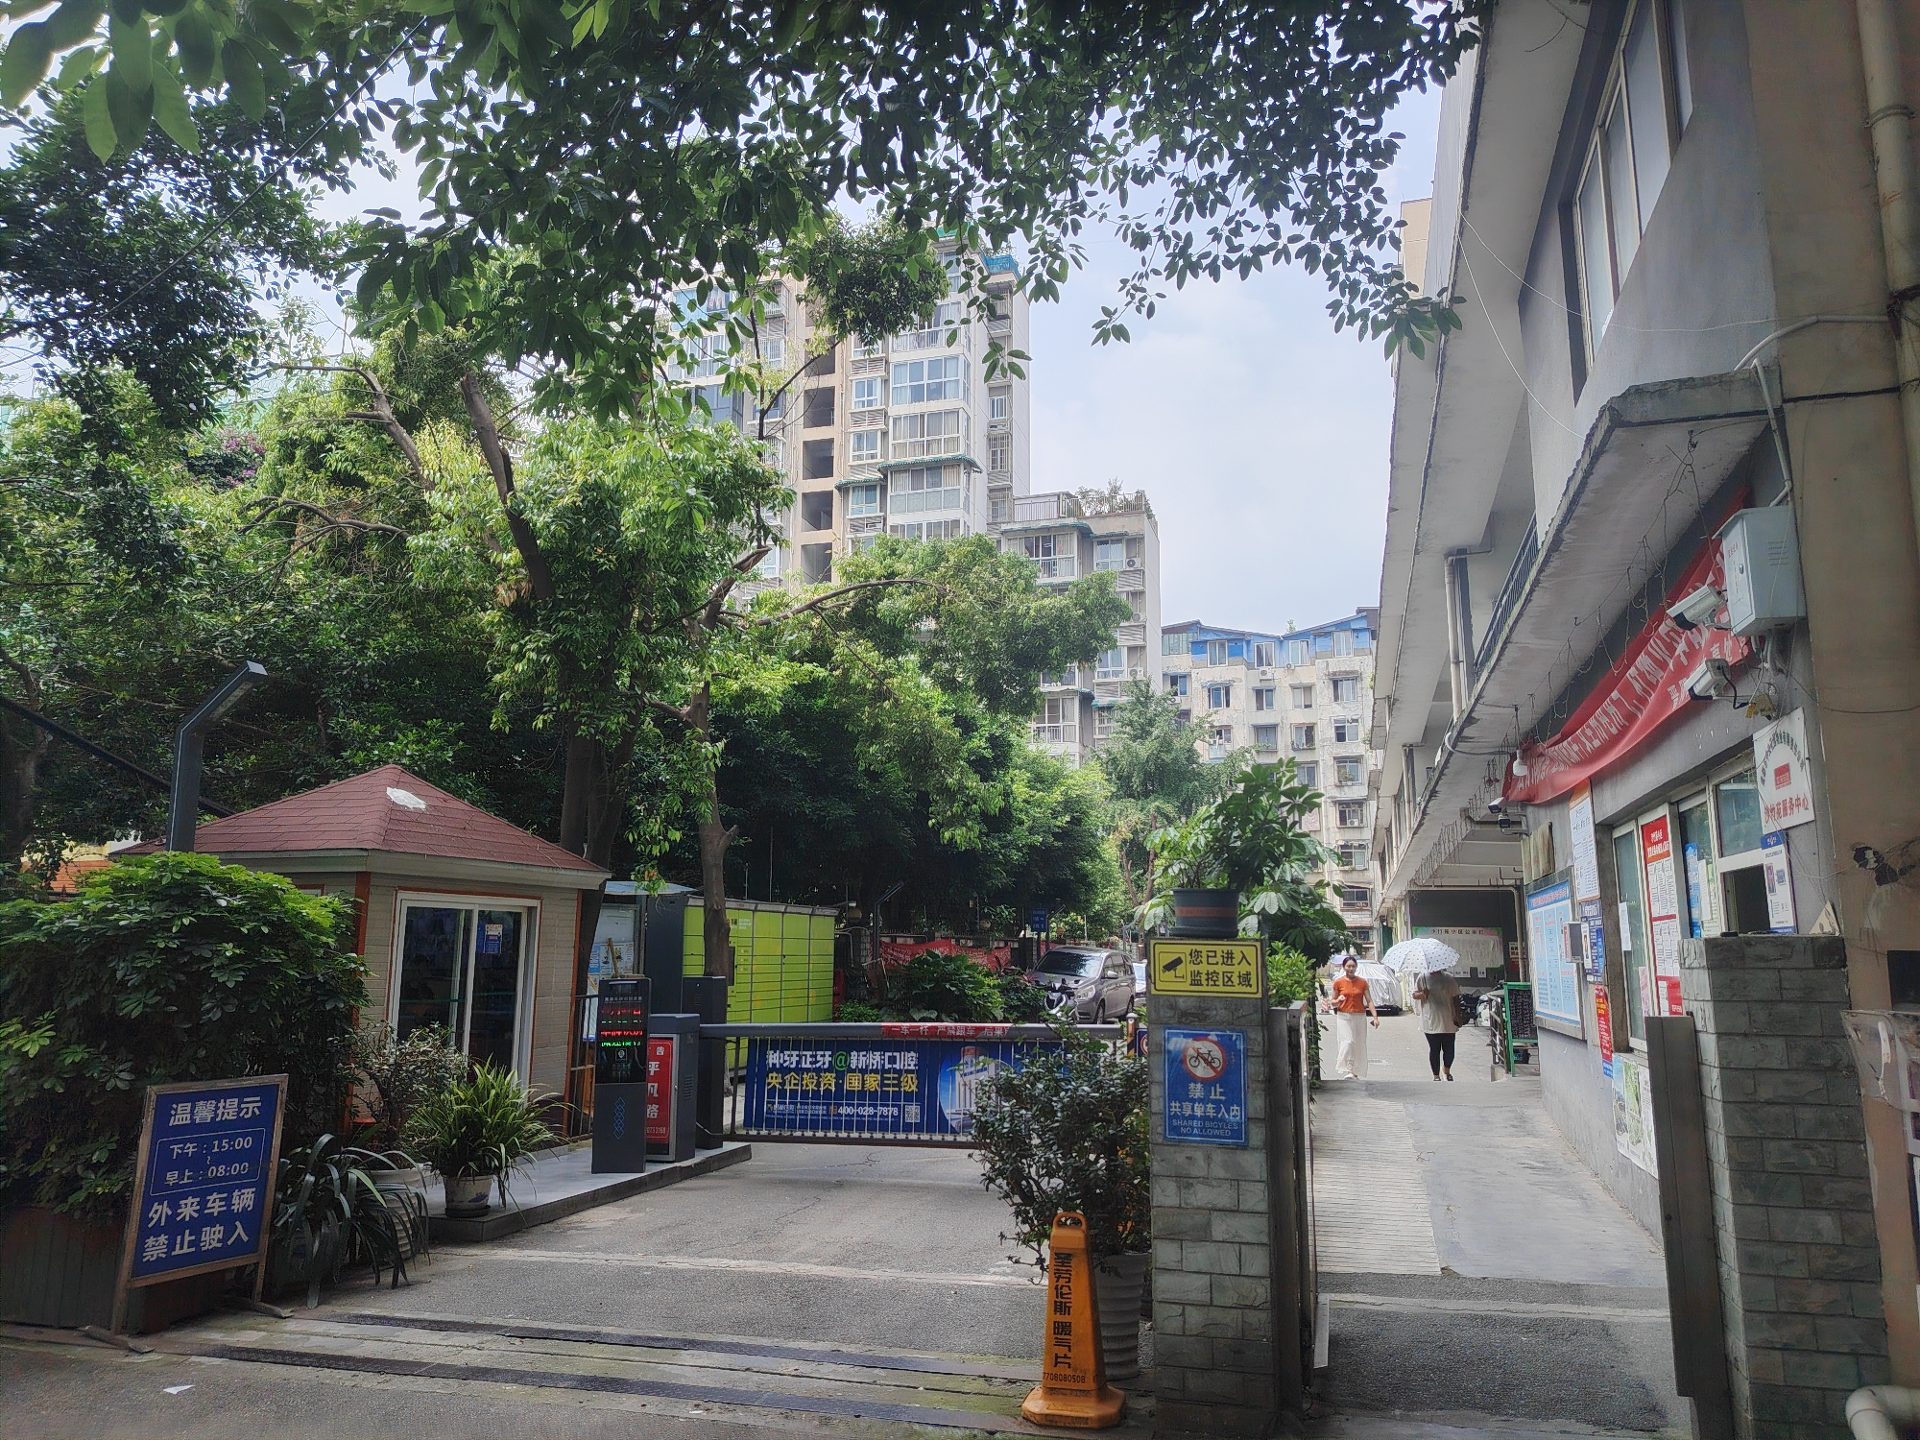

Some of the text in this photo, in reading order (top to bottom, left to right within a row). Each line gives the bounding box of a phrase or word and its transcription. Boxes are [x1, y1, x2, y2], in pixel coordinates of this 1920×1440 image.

[1188, 948, 1252, 966] 您已进入
[1189, 970, 1253, 988] 监控区域
[1188, 1082, 1226, 1100] 禁止
[168, 1096, 262, 1126] 温馨提示
[838, 1104, 899, 1116] 400-028-7878
[1169, 1101, 1241, 1120] 共享单车入内
[1172, 1119, 1203, 1128] SHARED
[1181, 1127, 1232, 1137] NO ALLOWED
[148, 1187, 256, 1228] 外来车辆
[142, 1220, 249, 1263] 禁止驶入
